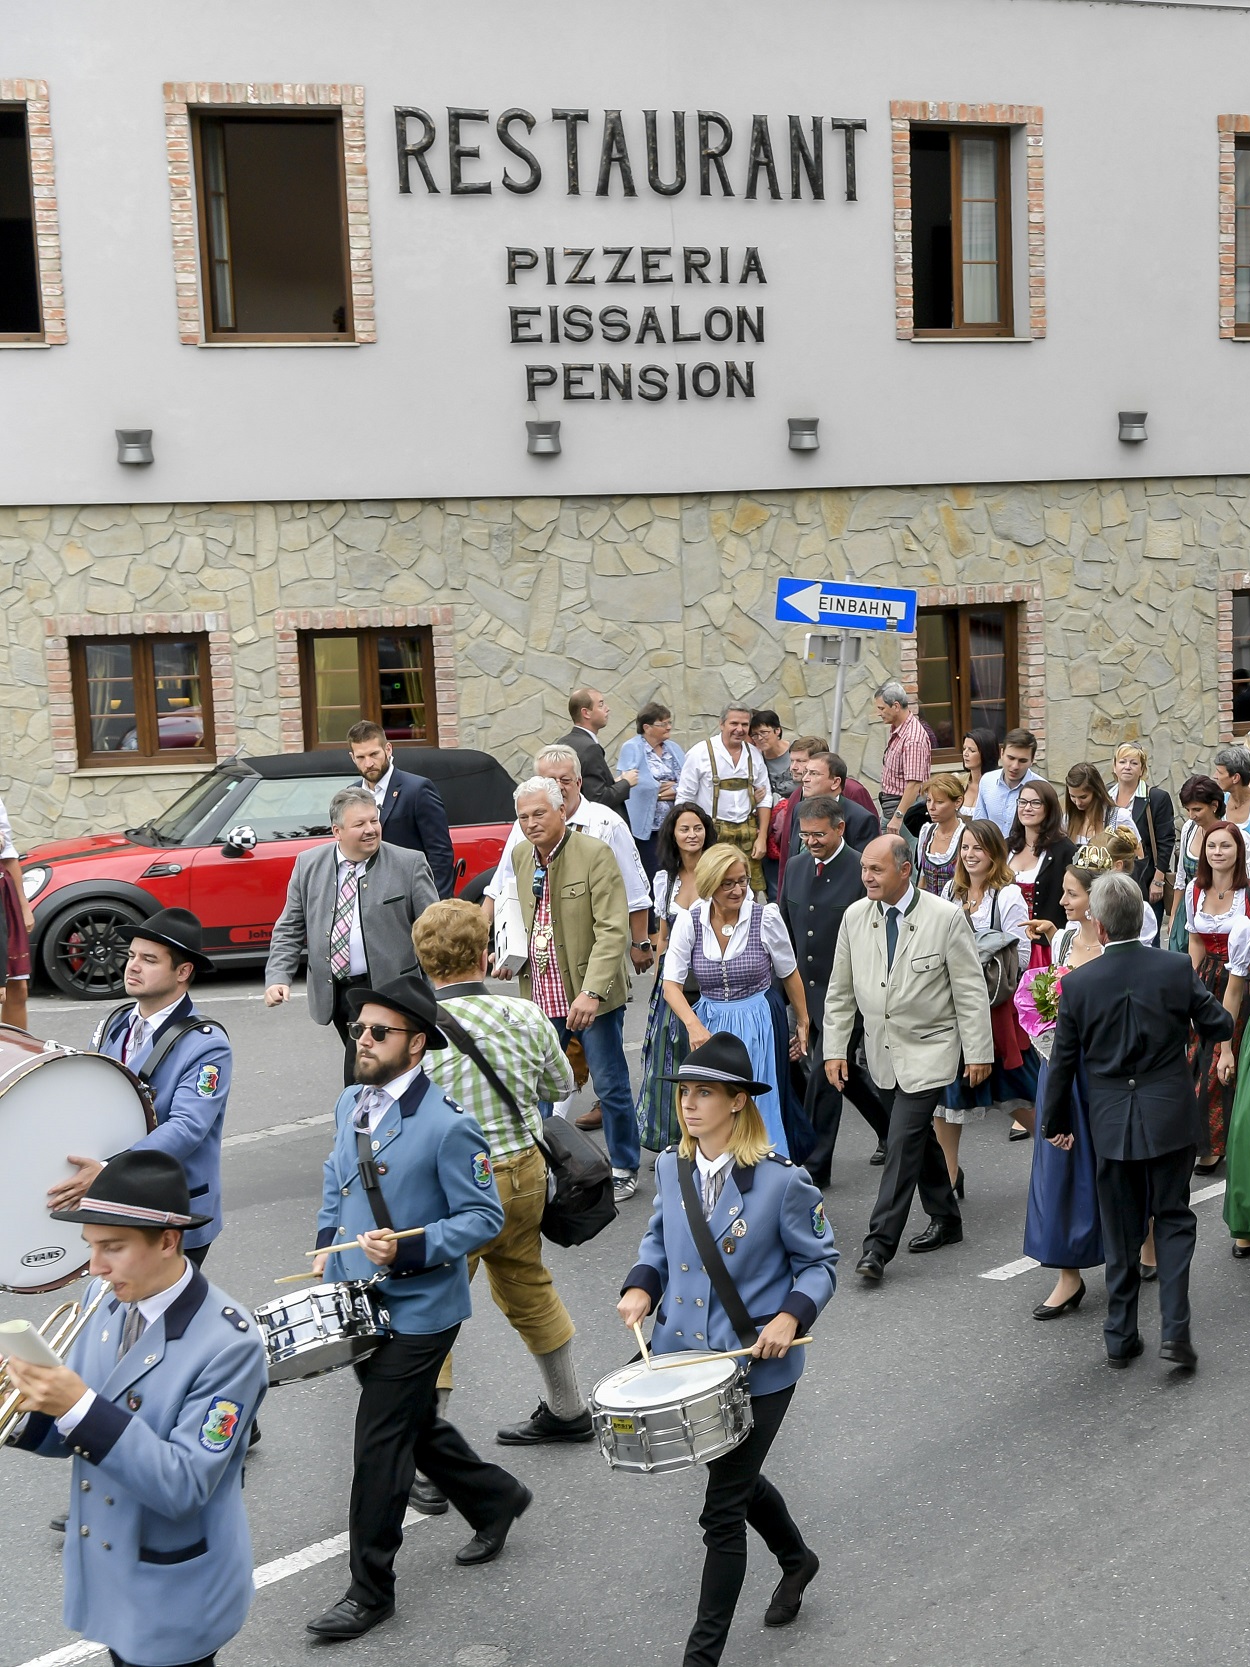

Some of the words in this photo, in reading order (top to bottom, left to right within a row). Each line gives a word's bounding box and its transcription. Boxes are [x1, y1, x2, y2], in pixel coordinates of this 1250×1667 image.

[393, 105, 868, 202] RESTAURANT
[505, 246, 767, 285] PIZZERIA
[508, 305, 765, 344] EISSALON
[525, 361, 756, 402] PENSION
[819, 596, 892, 617] EINBAHN
[26, 1250, 61, 1263] EVANS
